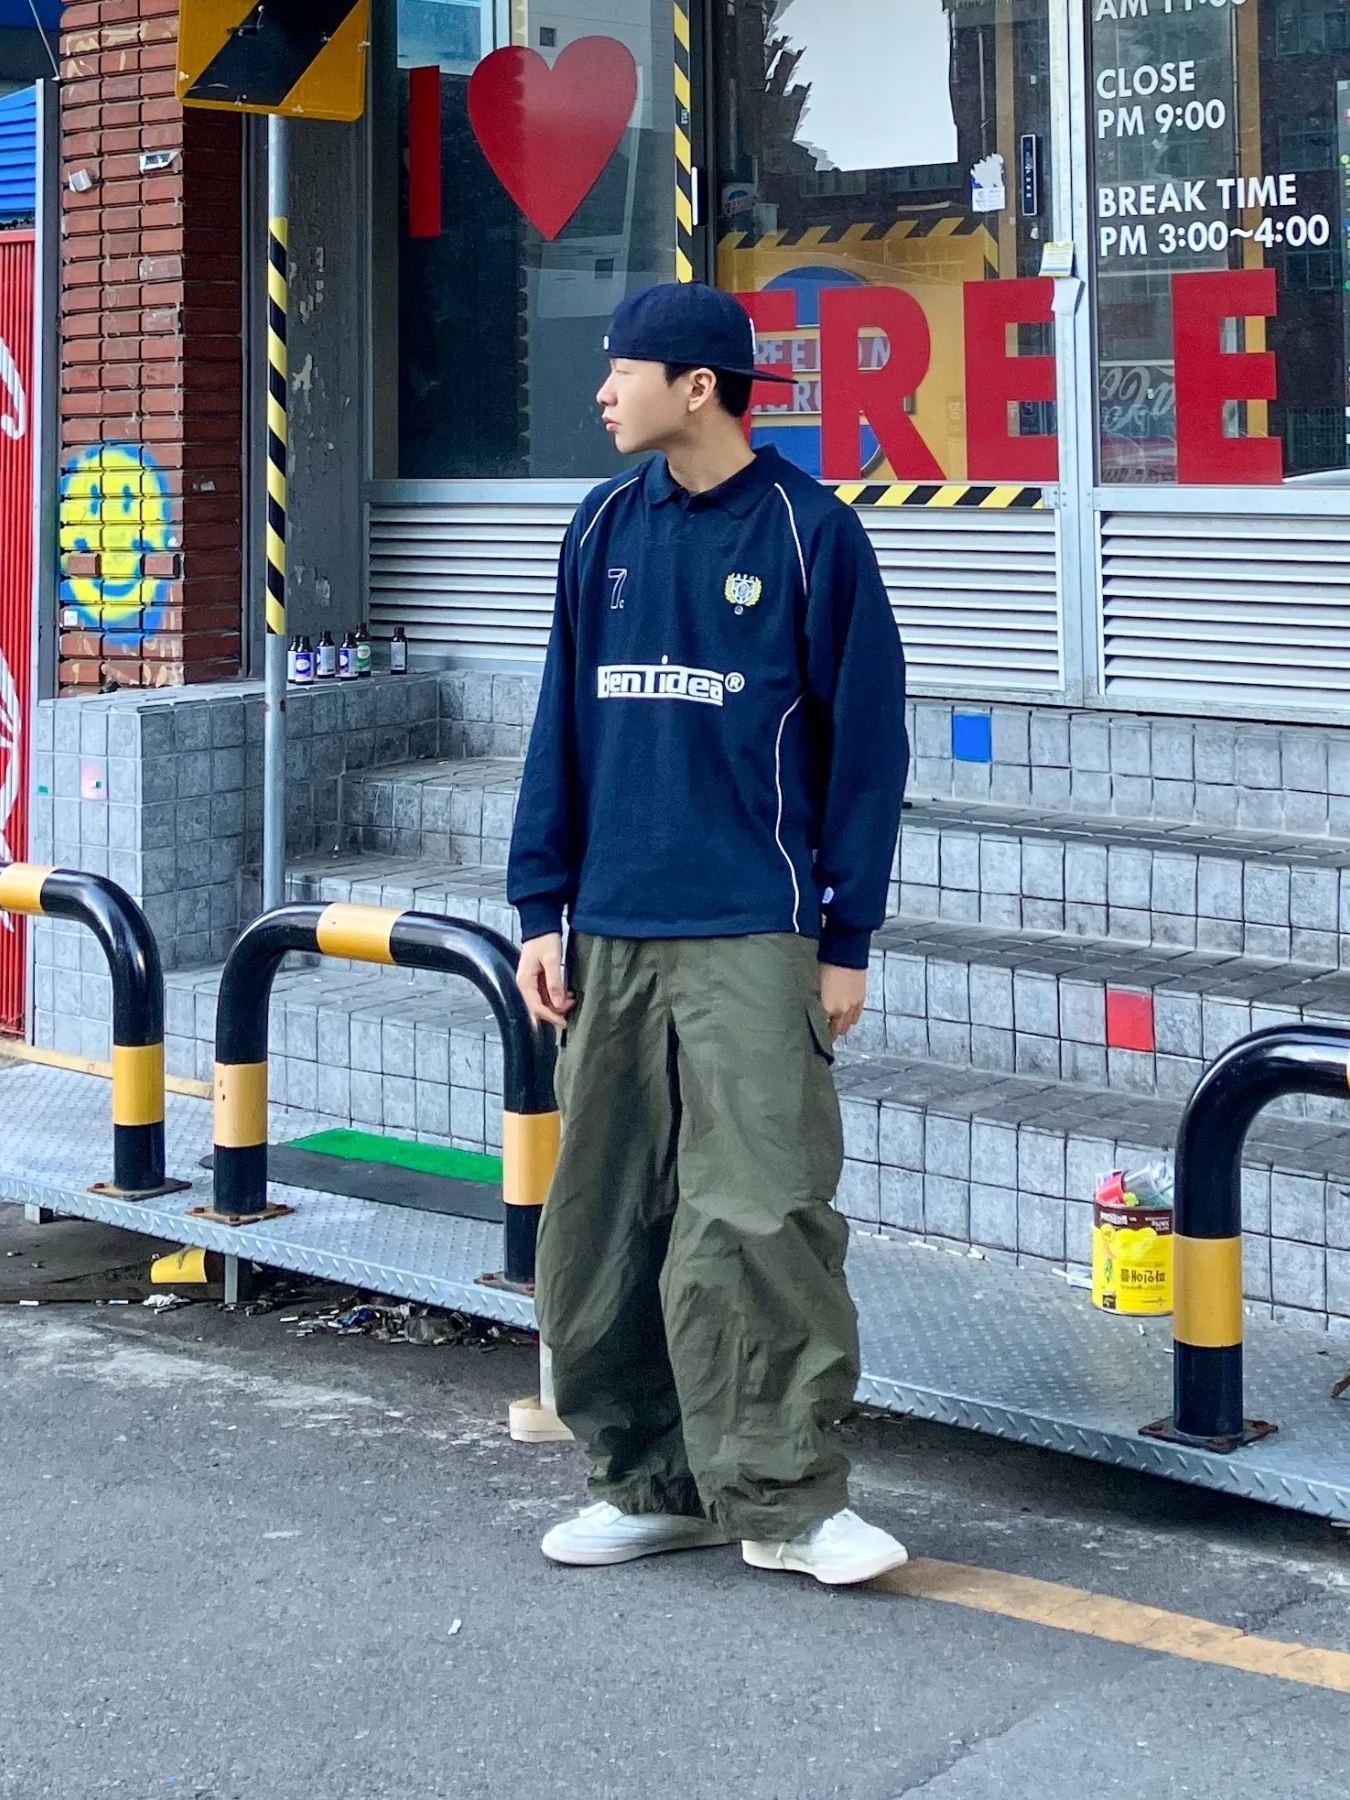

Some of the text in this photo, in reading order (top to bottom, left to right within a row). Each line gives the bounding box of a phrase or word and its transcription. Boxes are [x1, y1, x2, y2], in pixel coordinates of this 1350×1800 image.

[1095, 0, 1148, 21] AM
[1096, 60, 1195, 99] CLOSE
[1098, 99, 1226, 139] PM 9:00
[1098, 173, 1297, 218] BREAK TIME
[1100, 214, 1330, 257] PM 3:00~4:00
